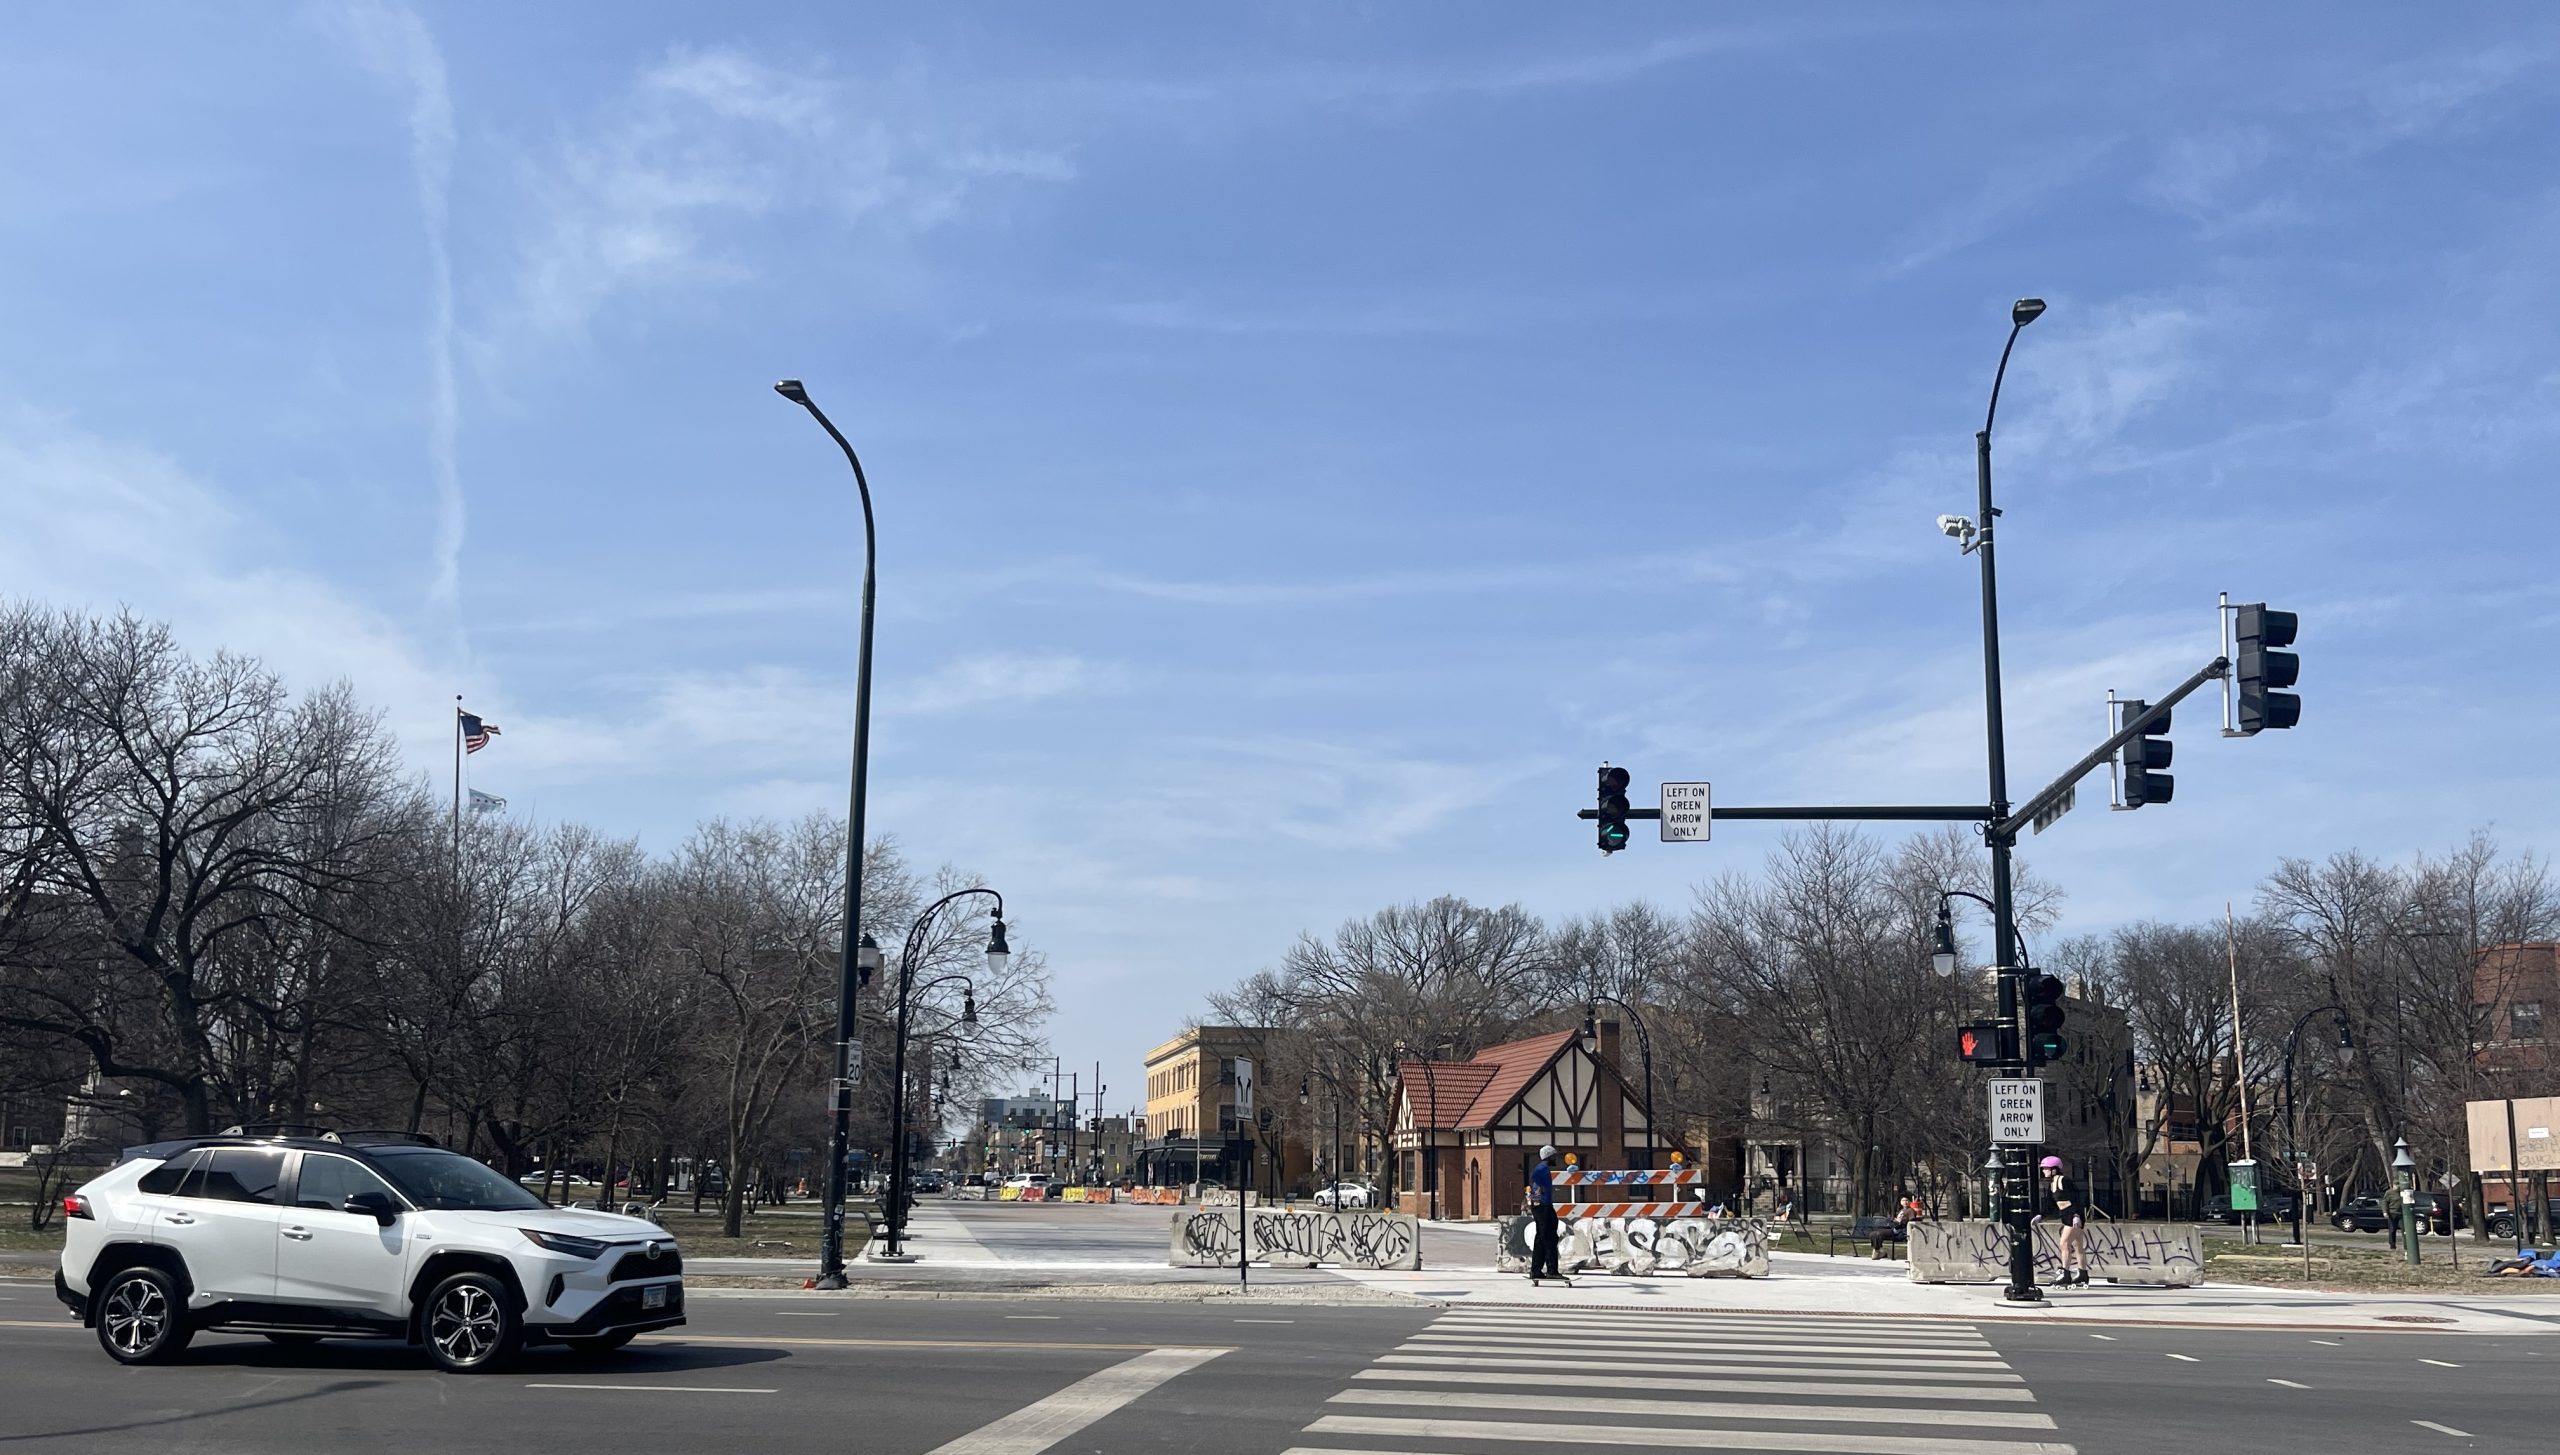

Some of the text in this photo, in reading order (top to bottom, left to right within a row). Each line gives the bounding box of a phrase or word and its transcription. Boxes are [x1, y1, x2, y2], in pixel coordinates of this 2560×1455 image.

[1667, 787, 1705, 797] LEFT ON
[1671, 801, 1701, 810] GREEN
[1670, 814, 1702, 823] ARROW
[1673, 827, 1698, 837] ONLY
[848, 1063, 860, 1081] 20
[1995, 1085, 2036, 1095] LEFT ON
[2000, 1099, 2032, 1108] GREEN
[2000, 1113, 2034, 1123] ARROW
[2004, 1127, 2030, 1137] ONLY
